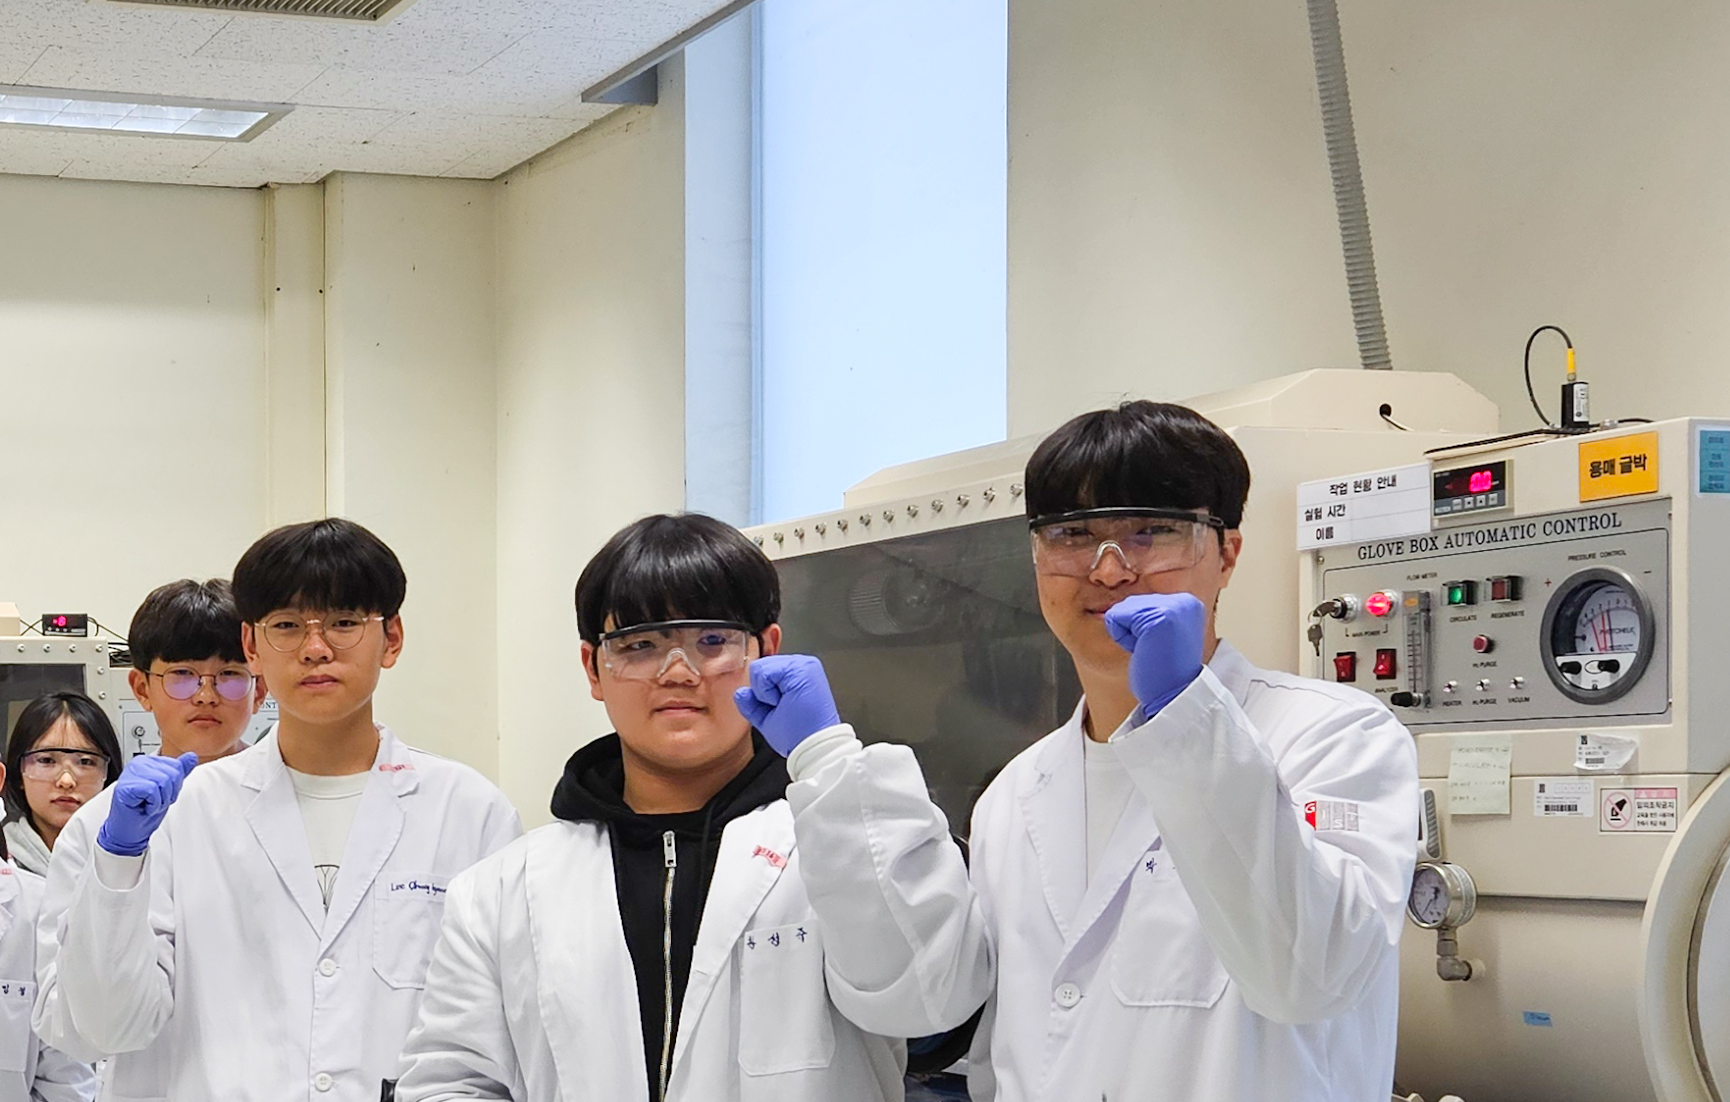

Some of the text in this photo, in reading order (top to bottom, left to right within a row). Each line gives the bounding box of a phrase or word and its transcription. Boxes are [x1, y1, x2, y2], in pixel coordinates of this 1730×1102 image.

[1589, 453, 1648, 479] 용매 글박
[1329, 474, 1397, 496] 작업 현황 안내
[1304, 503, 1346, 522] 실험 시간
[1315, 526, 1334, 541] 이름
[1358, 512, 1623, 561] GLOVE BOX AUTOMATIC CONTROL
